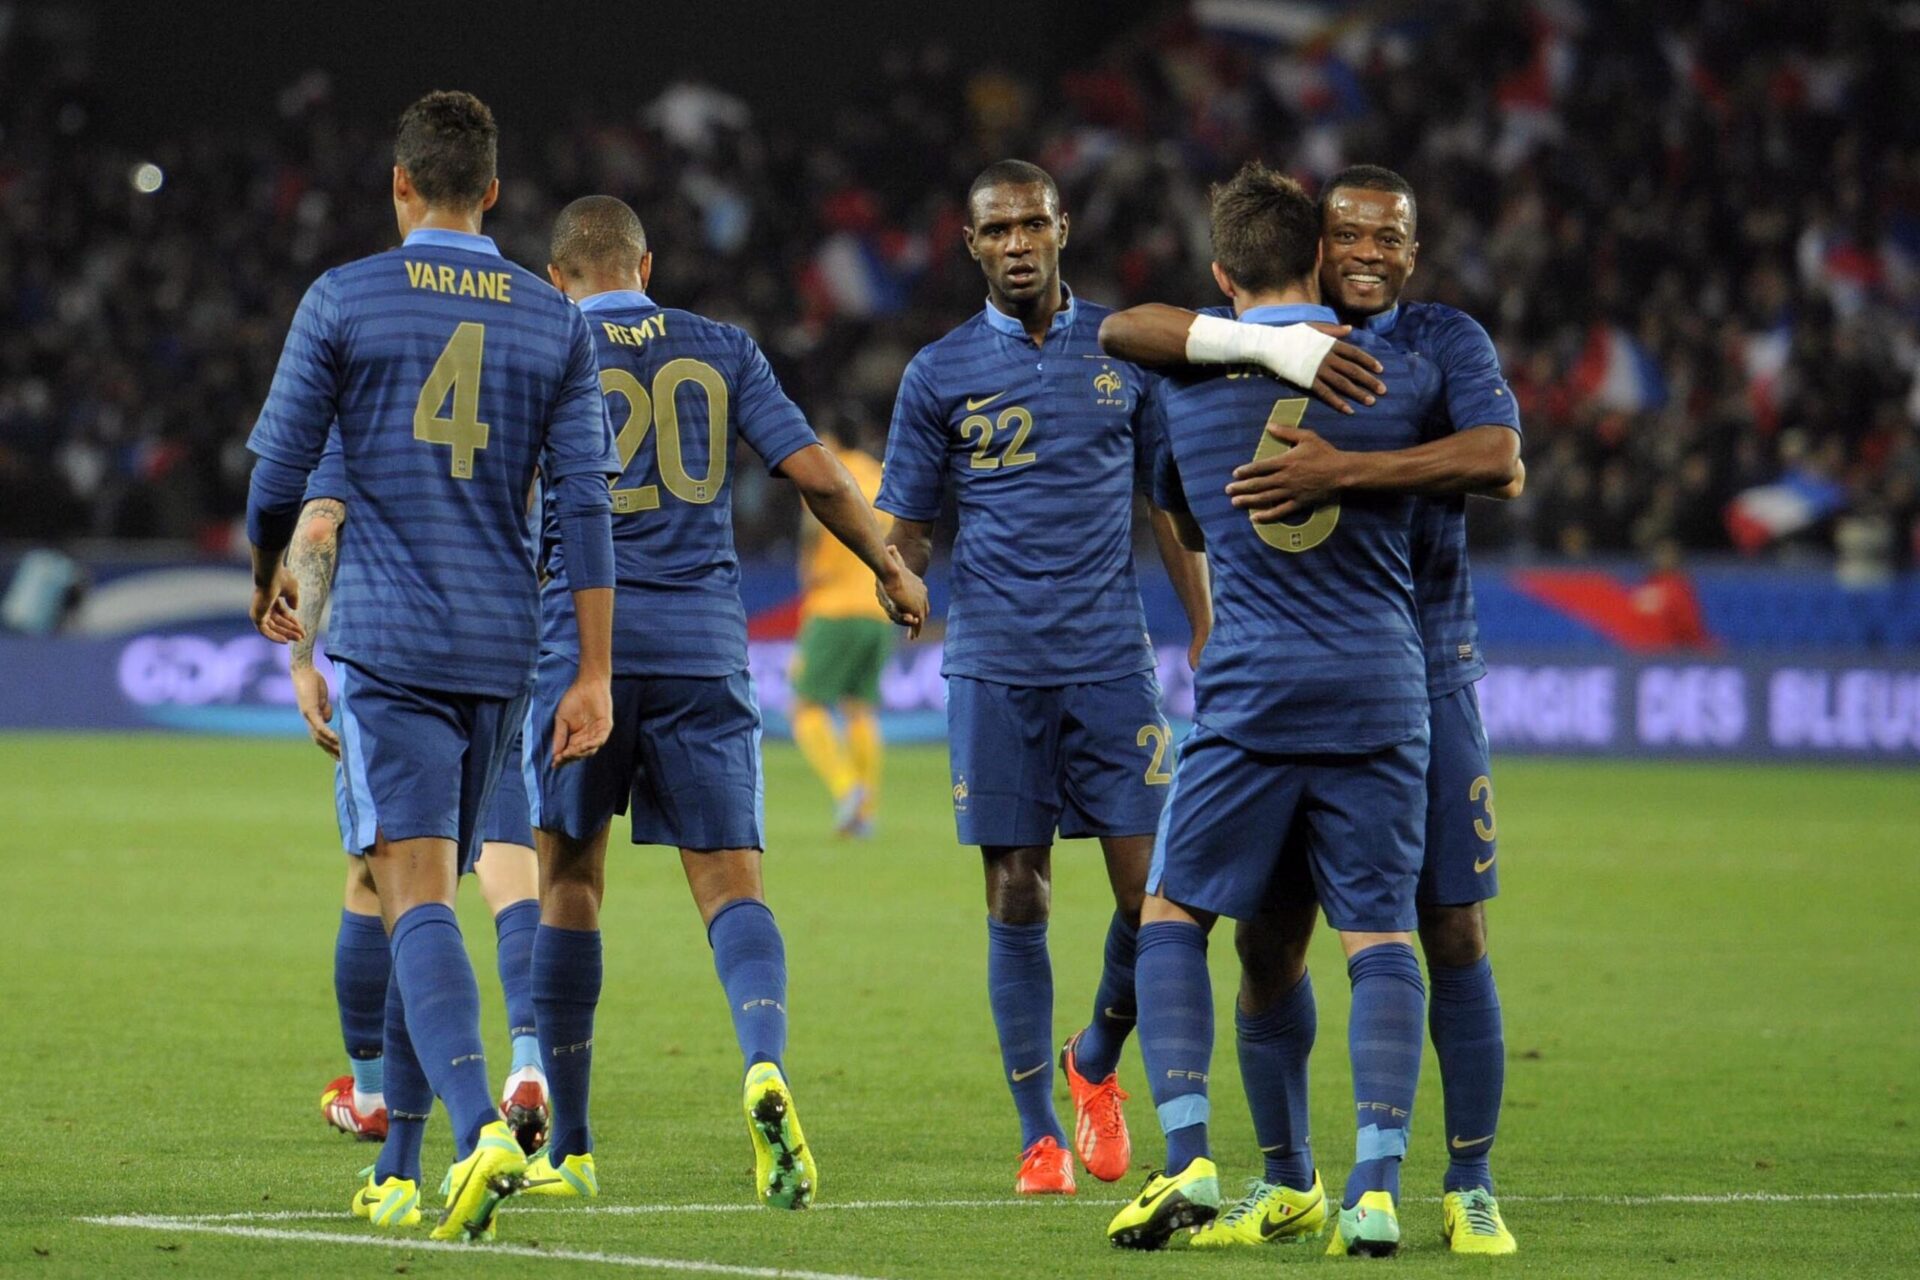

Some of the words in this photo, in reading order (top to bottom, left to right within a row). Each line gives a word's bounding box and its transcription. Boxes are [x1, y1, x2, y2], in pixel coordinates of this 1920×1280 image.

[405, 260, 512, 303] VARANE
[602, 313, 667, 346] REMY
[414, 321, 489, 479] 4
[599, 358, 729, 514] 20
[960, 406, 1036, 469] 22
[1249, 397, 1341, 553] 6
[1637, 665, 1746, 748] DES
[1768, 669, 1920, 750] BLEU
[1136, 724, 1172, 785] 2
[1469, 775, 1496, 842] 3
[1357, 1101, 1408, 1117] FFF
